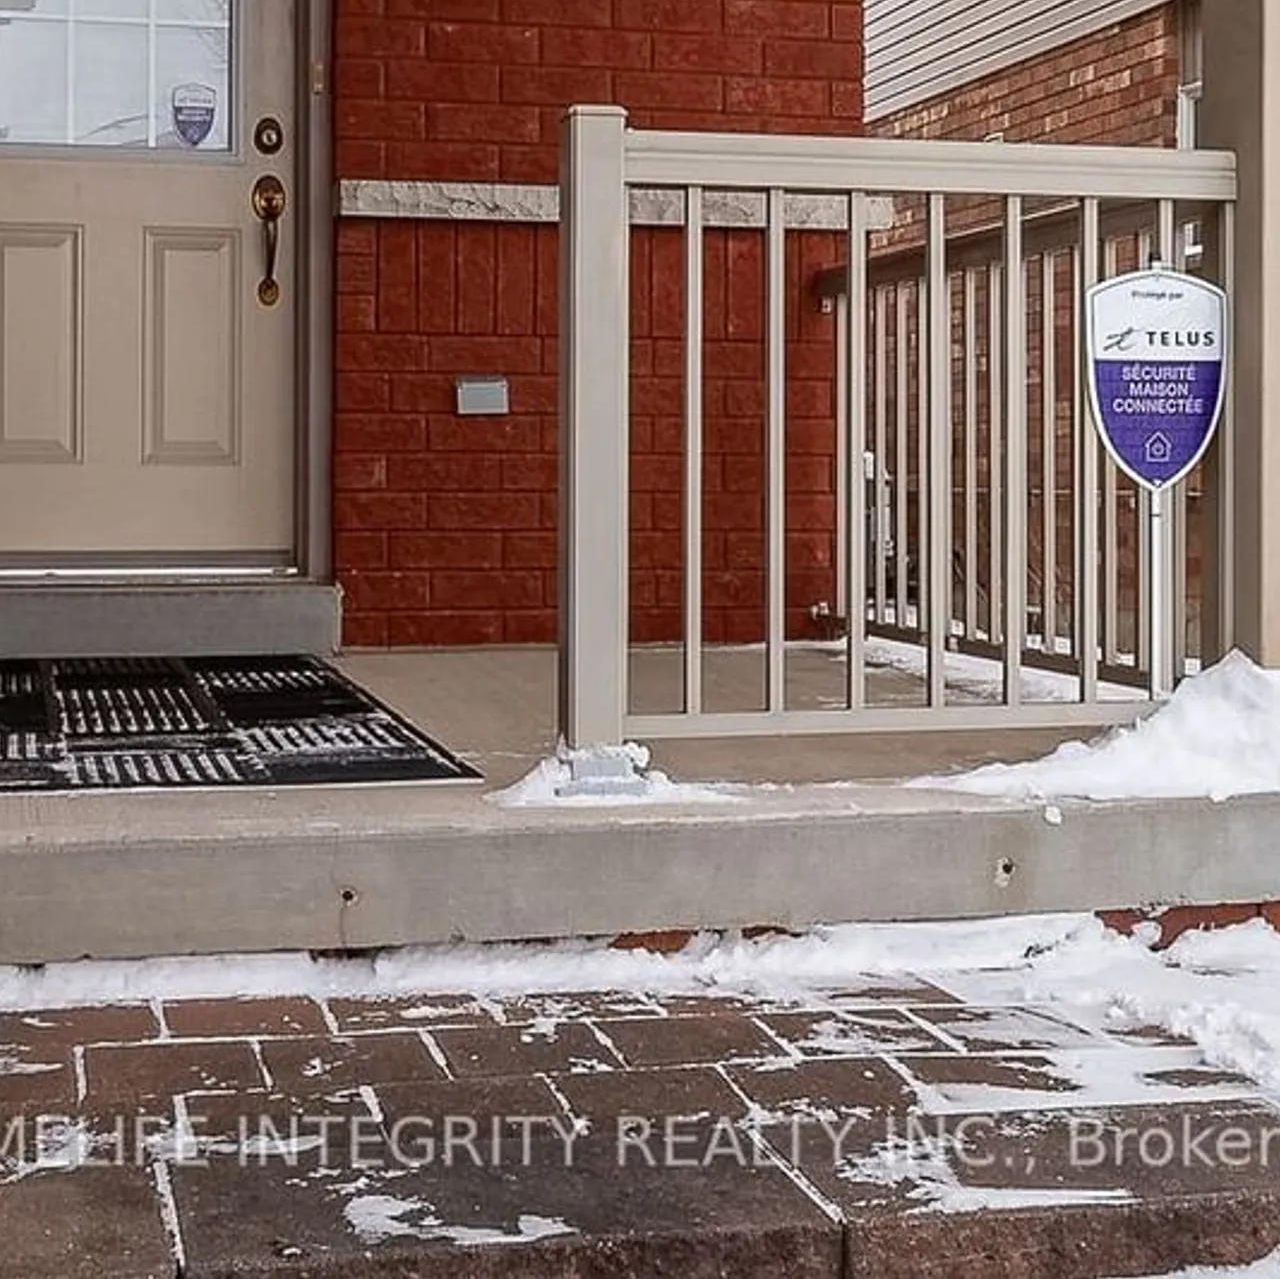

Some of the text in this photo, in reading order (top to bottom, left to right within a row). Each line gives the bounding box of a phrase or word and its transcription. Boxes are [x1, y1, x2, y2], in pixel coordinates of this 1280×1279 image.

[1145, 331, 1215, 347] TELUS
[1122, 362, 1196, 380] SÉCURITÉ
[1129, 382, 1189, 397] MAISON
[1113, 395, 1204, 413] CONNECTÉE
